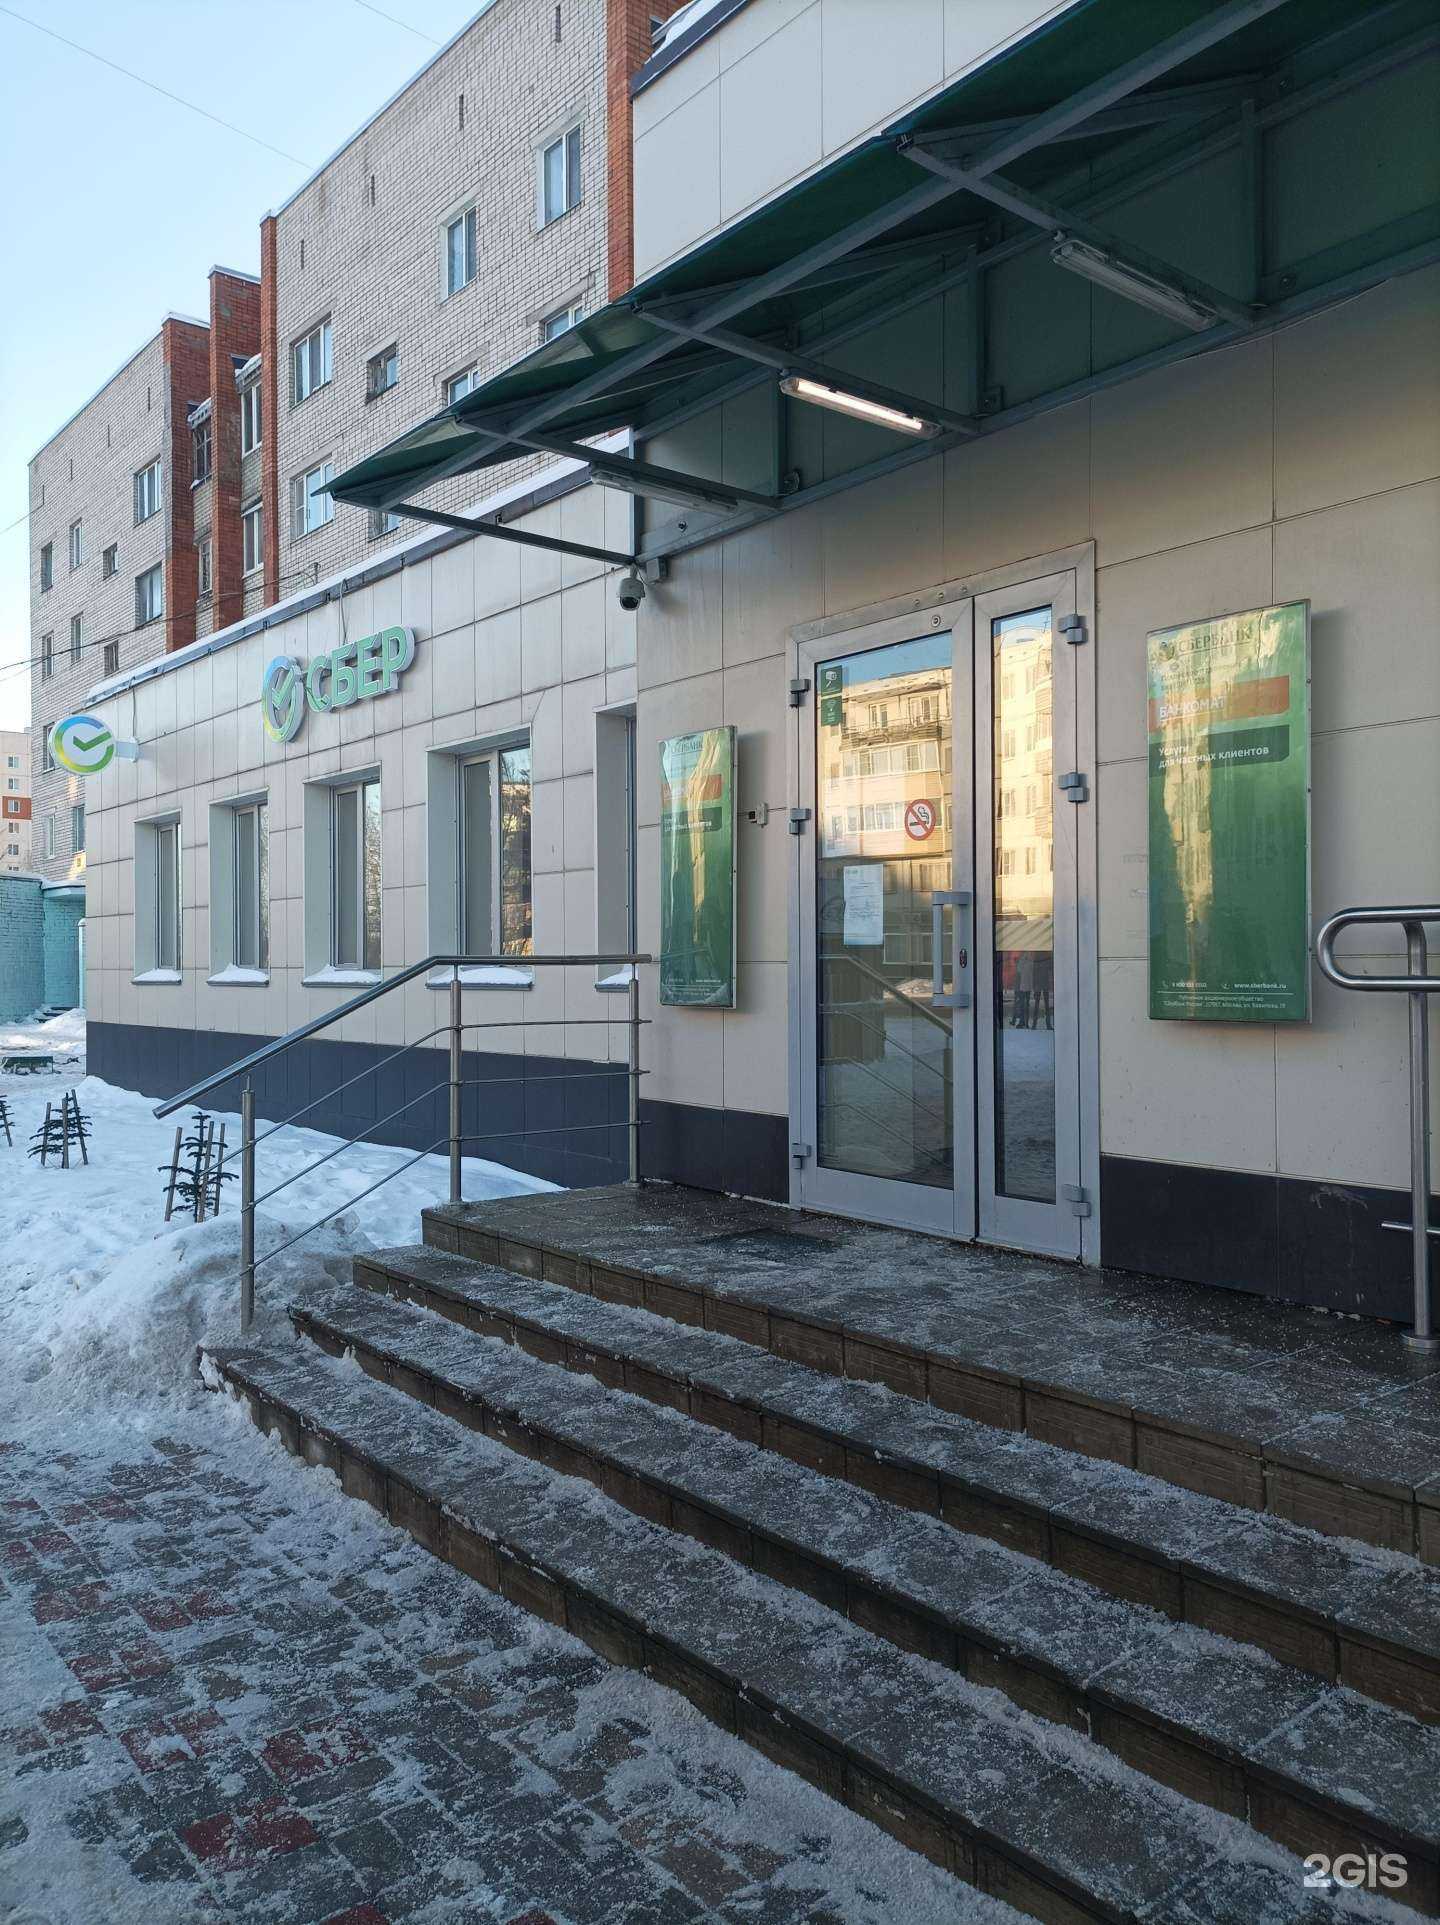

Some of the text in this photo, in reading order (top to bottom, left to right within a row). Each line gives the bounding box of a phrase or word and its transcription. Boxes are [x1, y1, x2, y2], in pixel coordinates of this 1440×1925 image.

[306, 624, 415, 713] СБЕР
[1159, 695, 1225, 718] БАНКОМАТ
[1218, 746, 1270, 760] клиентов
